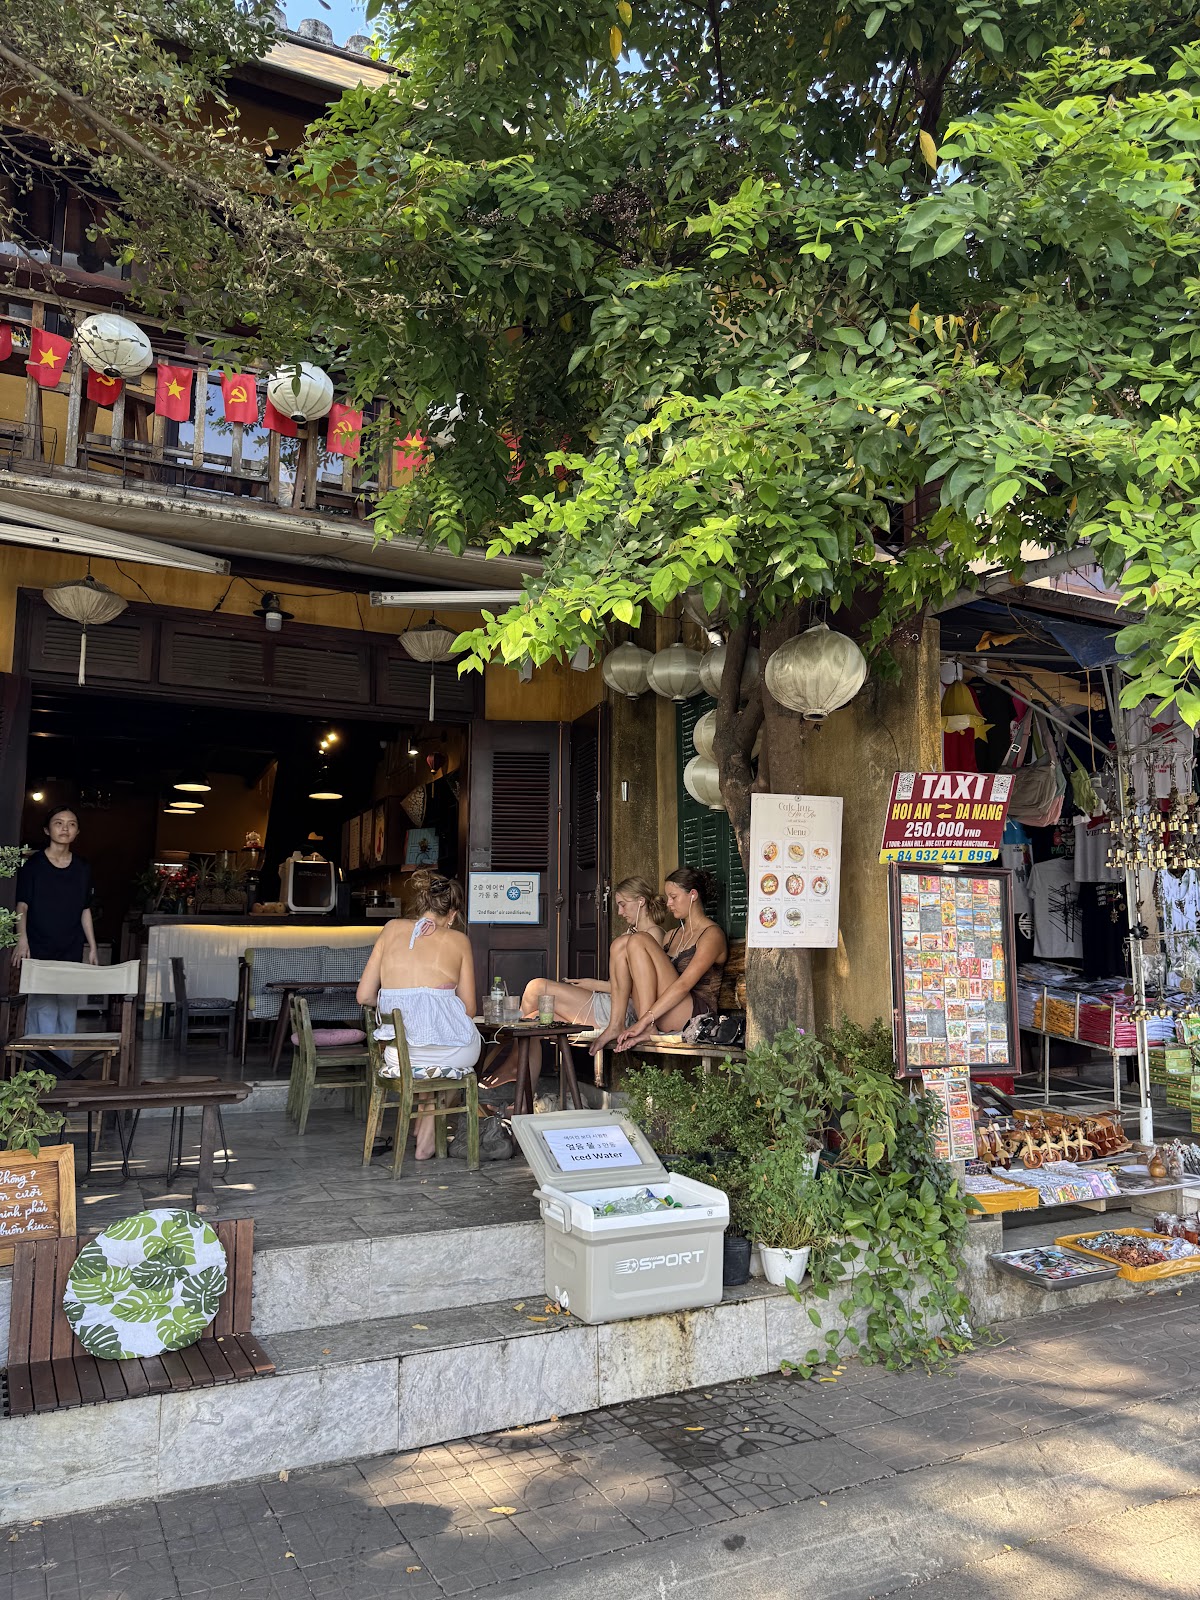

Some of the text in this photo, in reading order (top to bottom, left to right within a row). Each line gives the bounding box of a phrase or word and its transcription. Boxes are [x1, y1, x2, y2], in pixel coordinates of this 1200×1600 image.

[921, 775, 986, 799] TAXI
[892, 803, 1004, 820] HOI AN DA NANG
[786, 827, 807, 836] Menu
[904, 822, 981, 837] 250.000 VND
[897, 850, 912, 861] 84
[915, 850, 939, 861] 932
[941, 850, 963, 861] 441
[967, 850, 993, 861] 899
[571, 1154, 592, 1162] Iced
